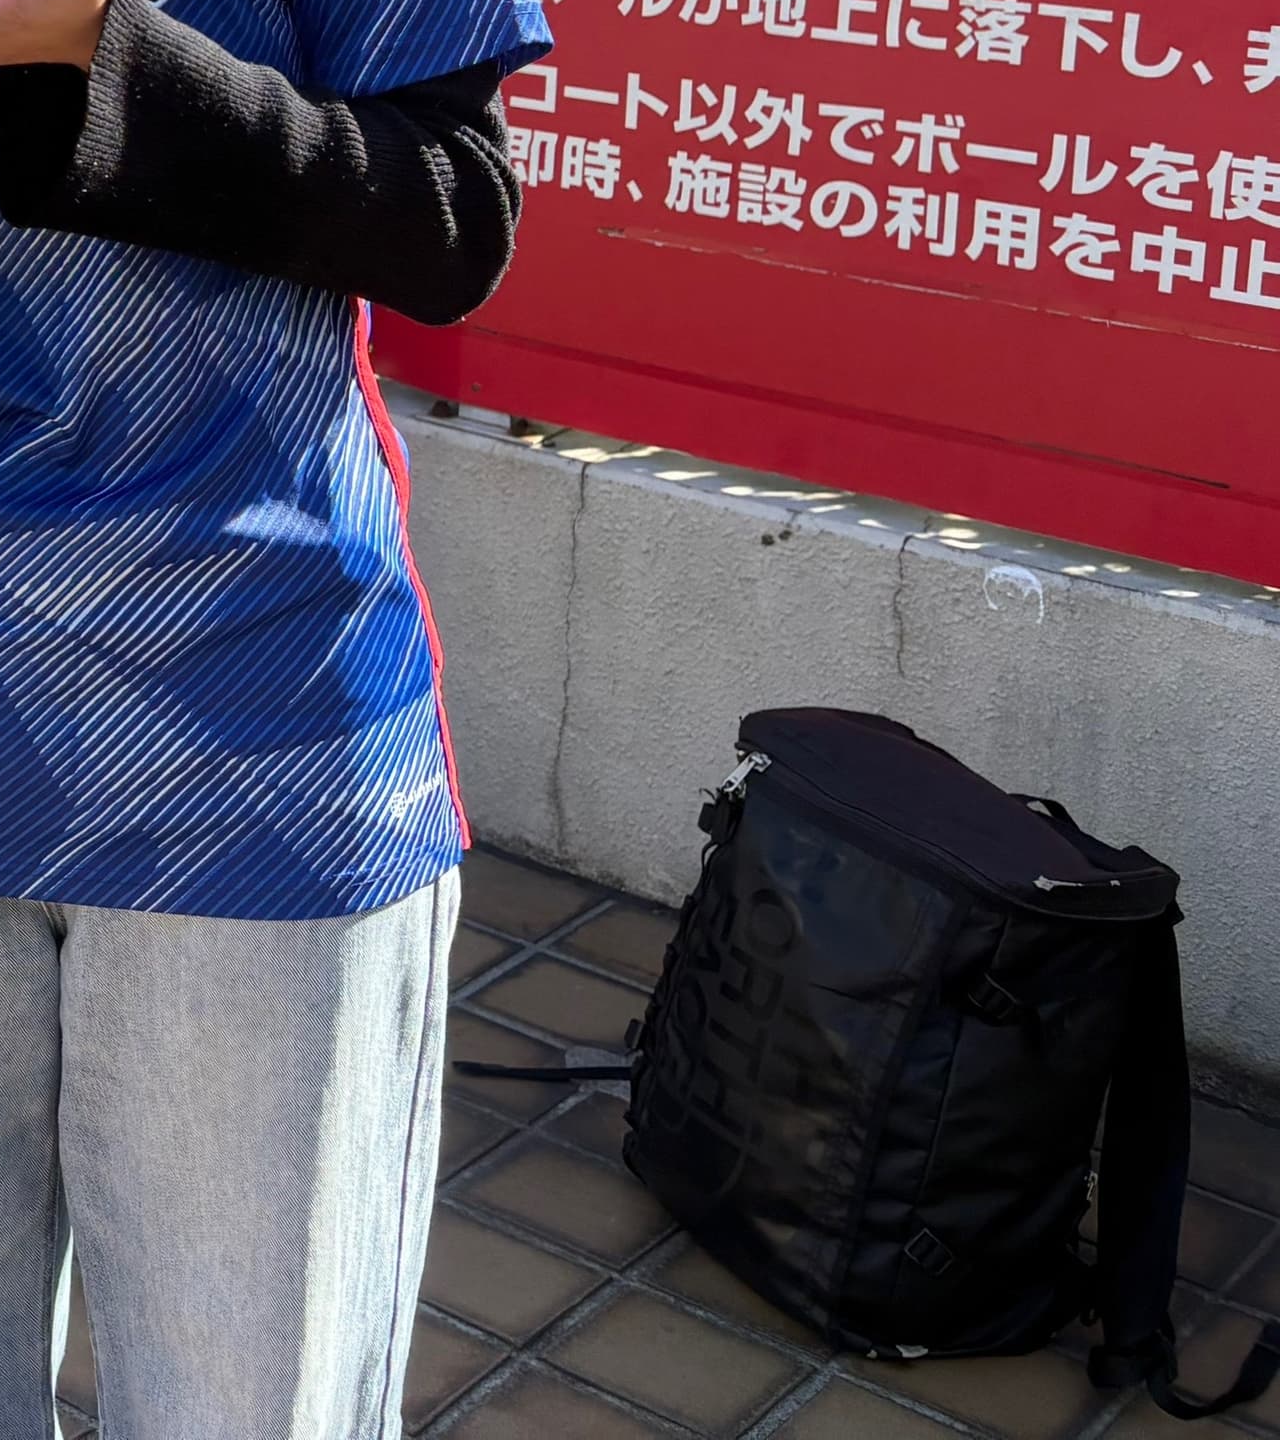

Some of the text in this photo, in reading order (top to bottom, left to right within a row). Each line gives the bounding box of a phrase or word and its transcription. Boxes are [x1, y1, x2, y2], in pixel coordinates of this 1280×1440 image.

[506, 125, 1280, 311] 即時、施設の利用を中止
[508, 61, 1280, 228] コート以外でボールを使
